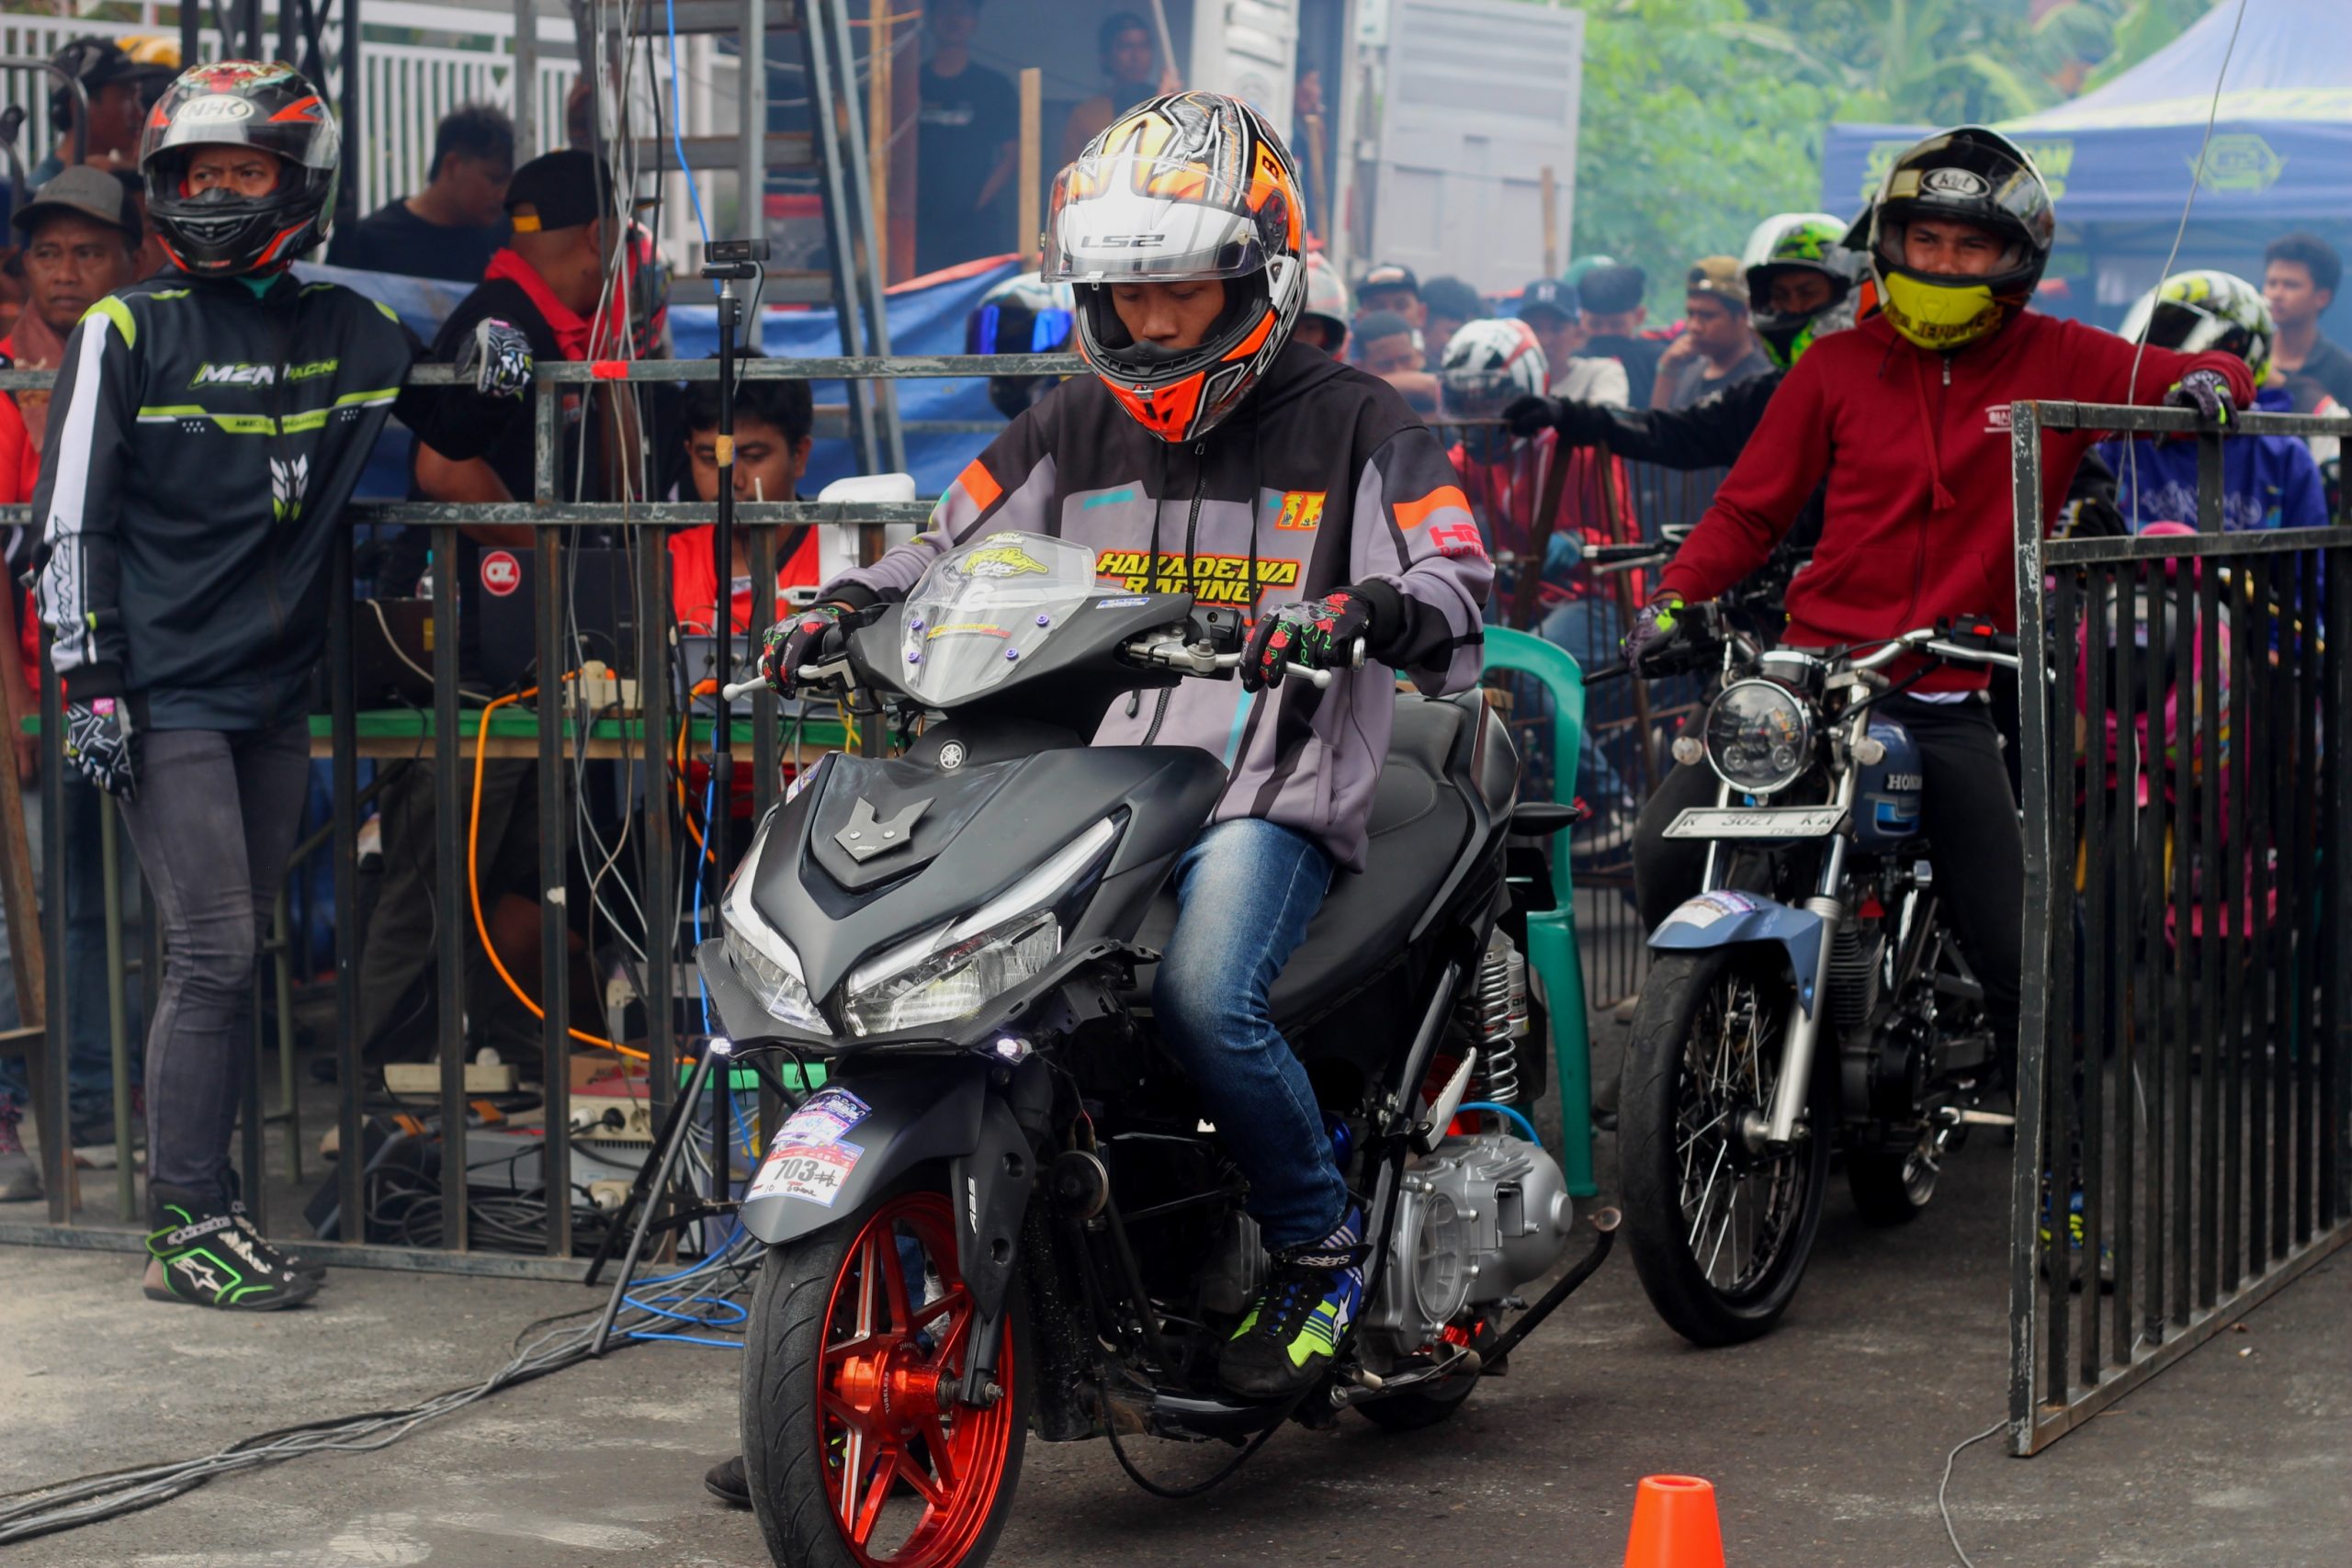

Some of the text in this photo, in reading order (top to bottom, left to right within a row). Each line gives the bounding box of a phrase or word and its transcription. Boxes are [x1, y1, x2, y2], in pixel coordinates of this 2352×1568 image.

[1080, 234, 1165, 248] LS2
[1096, 551, 1297, 584] HAKADEWA
[1887, 774, 1922, 790] HON
[967, 1176, 978, 1234] ABS
[1296, 1254, 1351, 1267] estars
